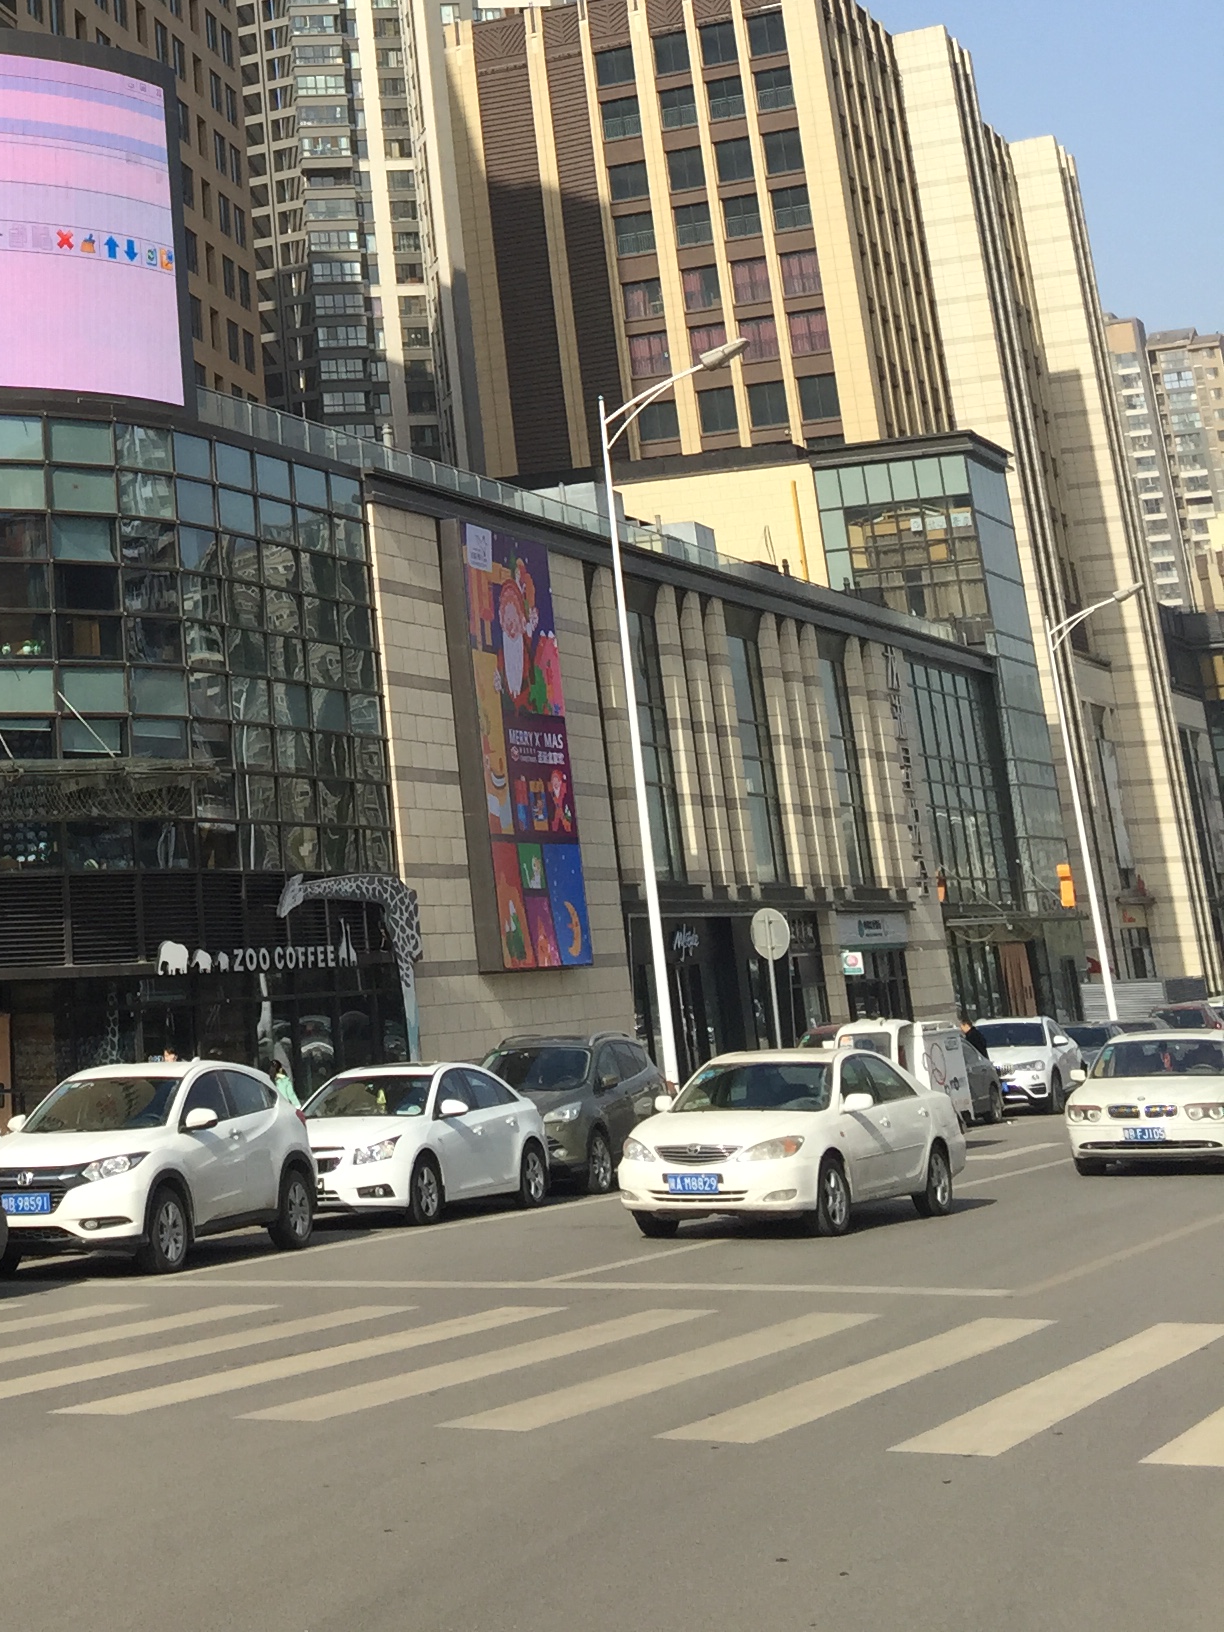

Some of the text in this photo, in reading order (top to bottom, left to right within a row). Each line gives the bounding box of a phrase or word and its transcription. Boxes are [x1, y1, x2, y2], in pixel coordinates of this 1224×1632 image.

[508, 728, 533, 747] MERRY
[233, 945, 337, 972] ZOO COFFEE
